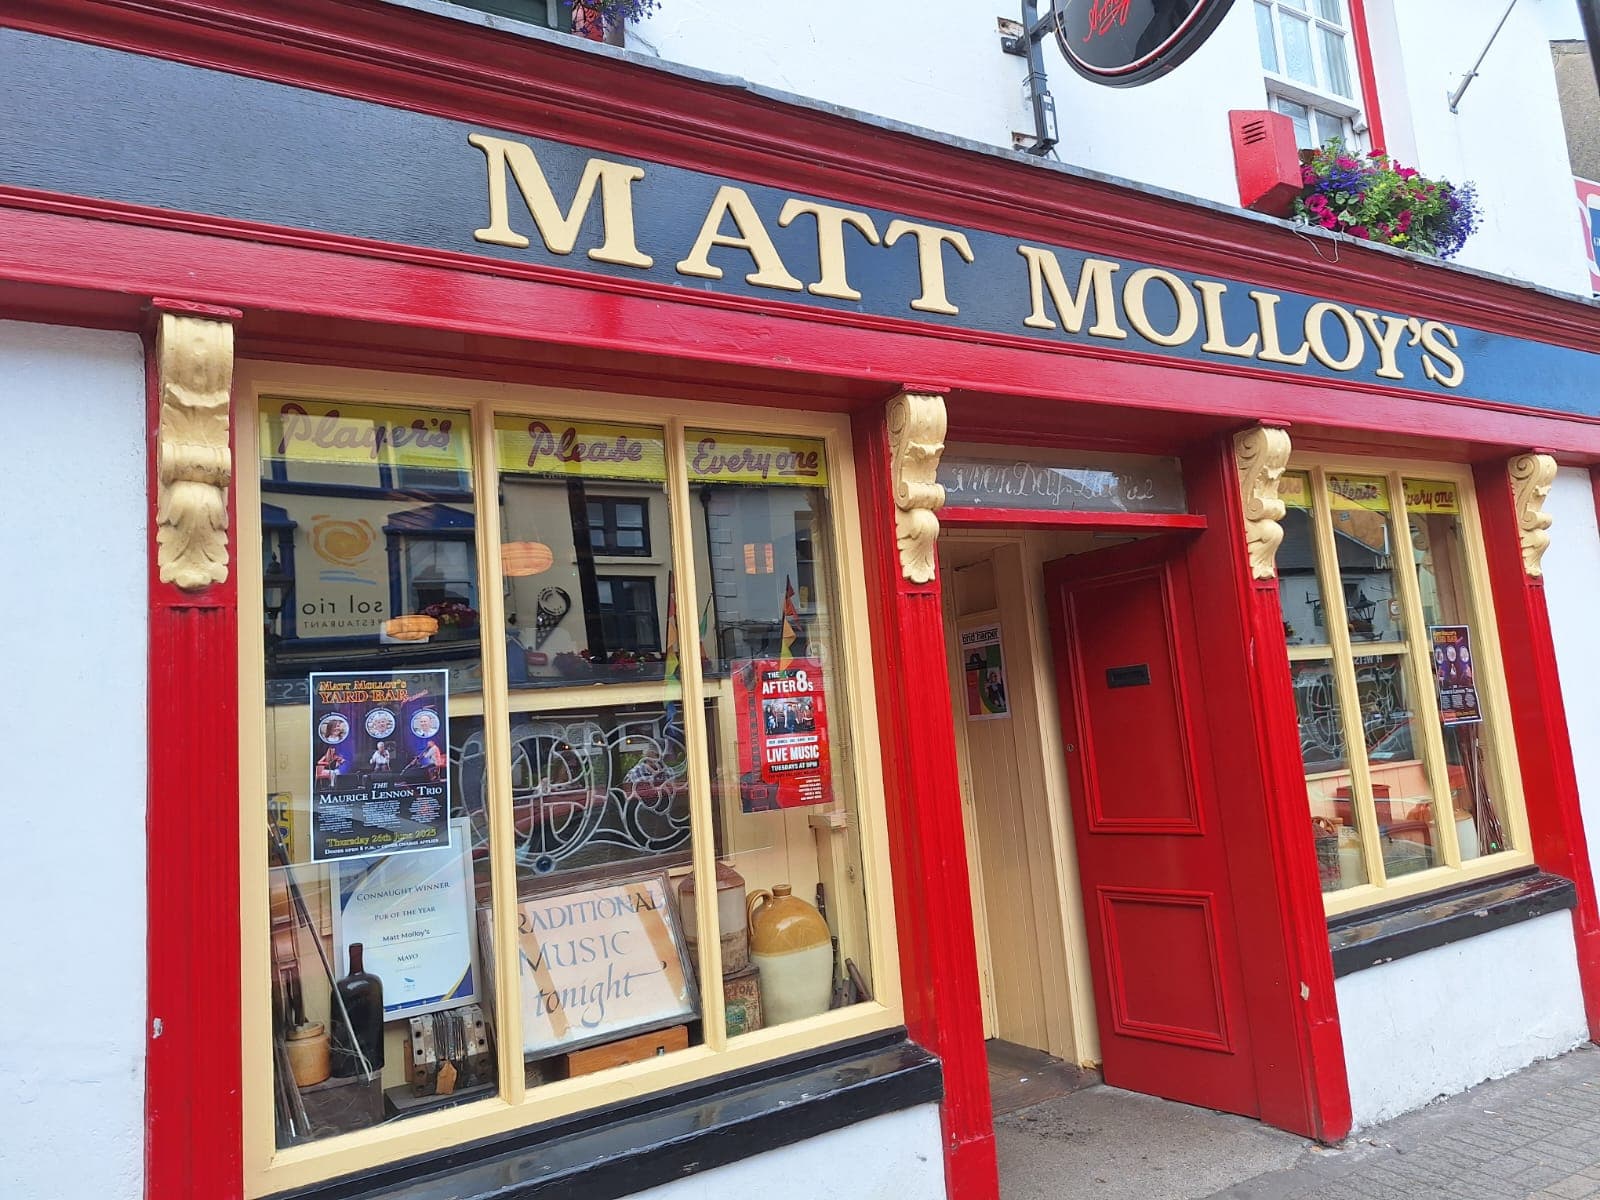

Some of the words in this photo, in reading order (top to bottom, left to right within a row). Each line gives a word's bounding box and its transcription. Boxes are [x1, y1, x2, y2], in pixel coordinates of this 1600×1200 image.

[468, 133, 975, 315] MATT
[1017, 245, 1466, 388] MOLLOY'S
[278, 402, 453, 459] Player's
[527, 420, 643, 467] Please
[319, 690, 369, 704] YARD
[372, 688, 409, 702] BAR
[762, 680, 795, 695] AFTER
[766, 747, 789, 762] LIVE
[789, 744, 820, 760] MUSIC
[319, 793, 369, 804] MAURICE
[371, 789, 414, 800] LENNON
[416, 785, 442, 796] TRIO
[326, 836, 370, 848] Thursday
[356, 886, 412, 902] CONNAUGHT
[415, 881, 450, 893] WINNER
[403, 909, 417, 917] THE
[418, 906, 436, 914] YEAR
[518, 890, 664, 934] RADITIONAL
[382, 934, 399, 942] Matt
[401, 928, 431, 940] Molloy's
[397, 953, 419, 963] MAYO
[518, 930, 630, 977] MUSIC
[535, 962, 667, 1028] tonight
